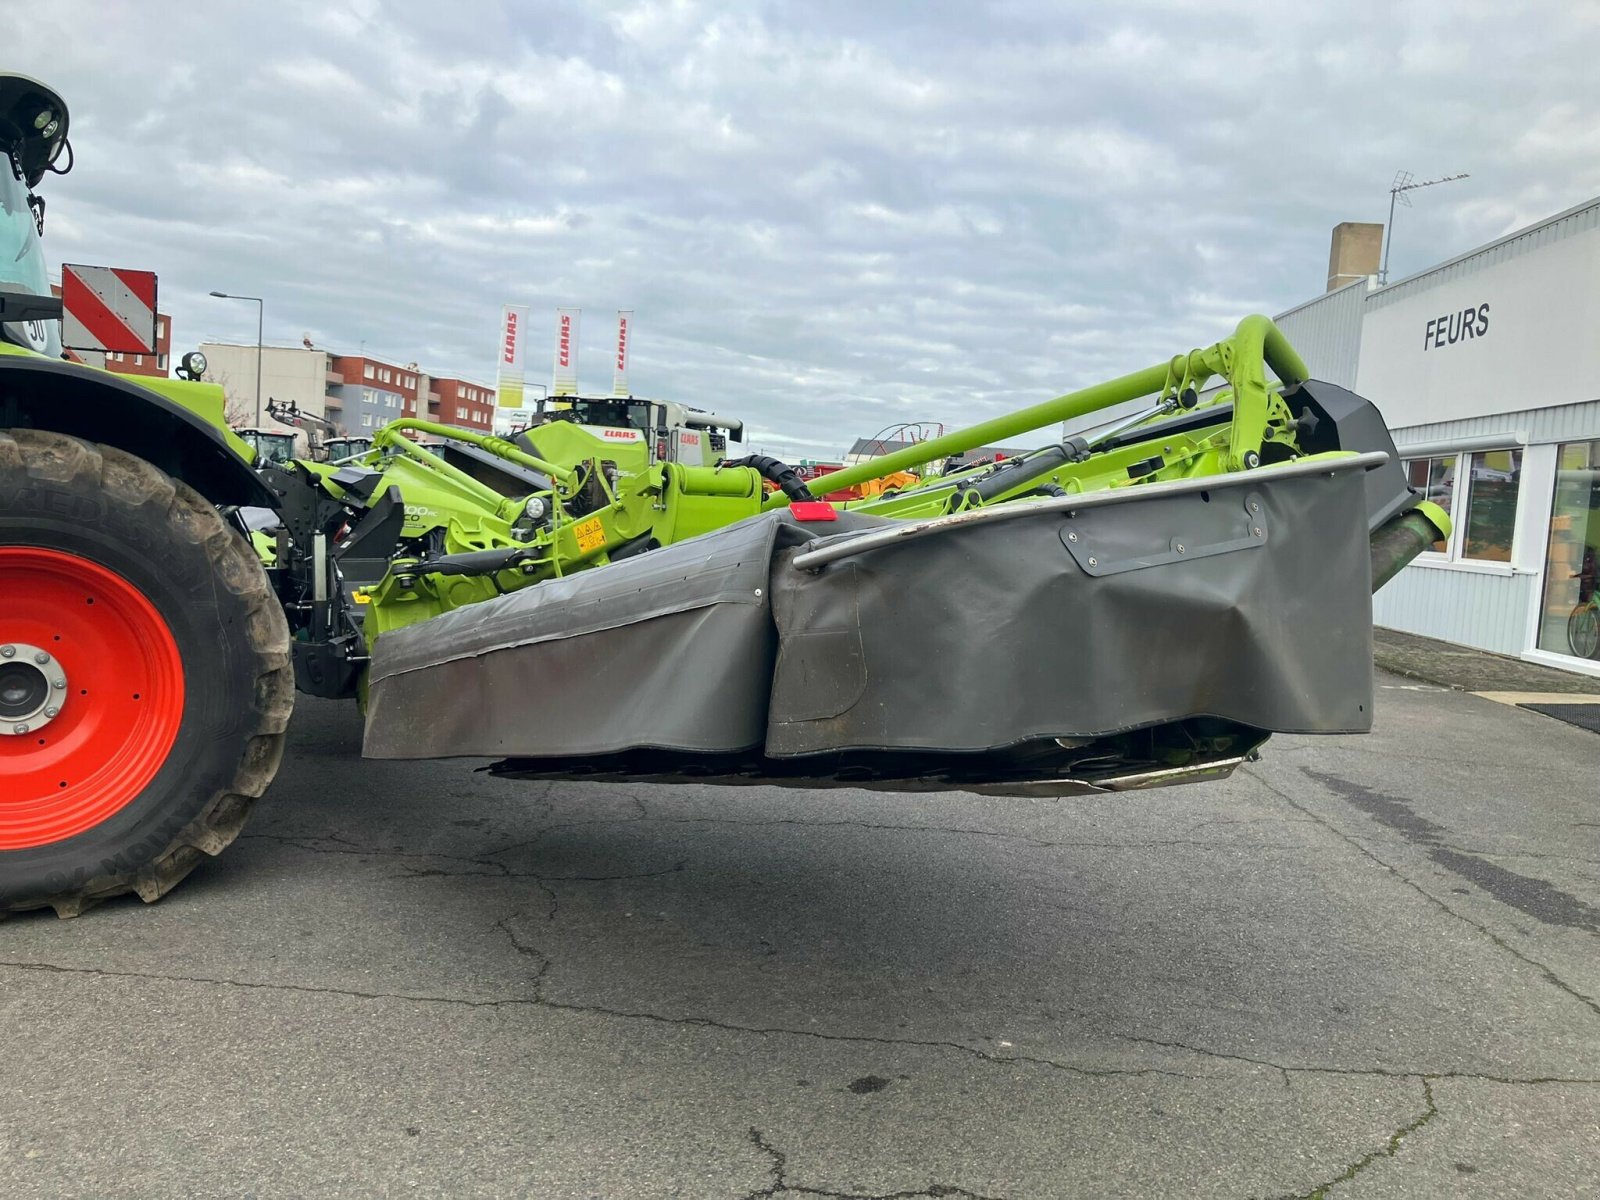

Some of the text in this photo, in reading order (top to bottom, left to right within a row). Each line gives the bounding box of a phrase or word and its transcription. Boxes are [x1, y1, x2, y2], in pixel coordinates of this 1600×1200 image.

[504, 312, 517, 364] CLAAS
[559, 315, 570, 367] CLAAS
[617, 318, 627, 371] CLAAS
[1424, 303, 1490, 351] FEURS
[604, 430, 637, 439] CLAAS
[680, 433, 699, 446] CLAAS
[404, 505, 428, 515] 00
